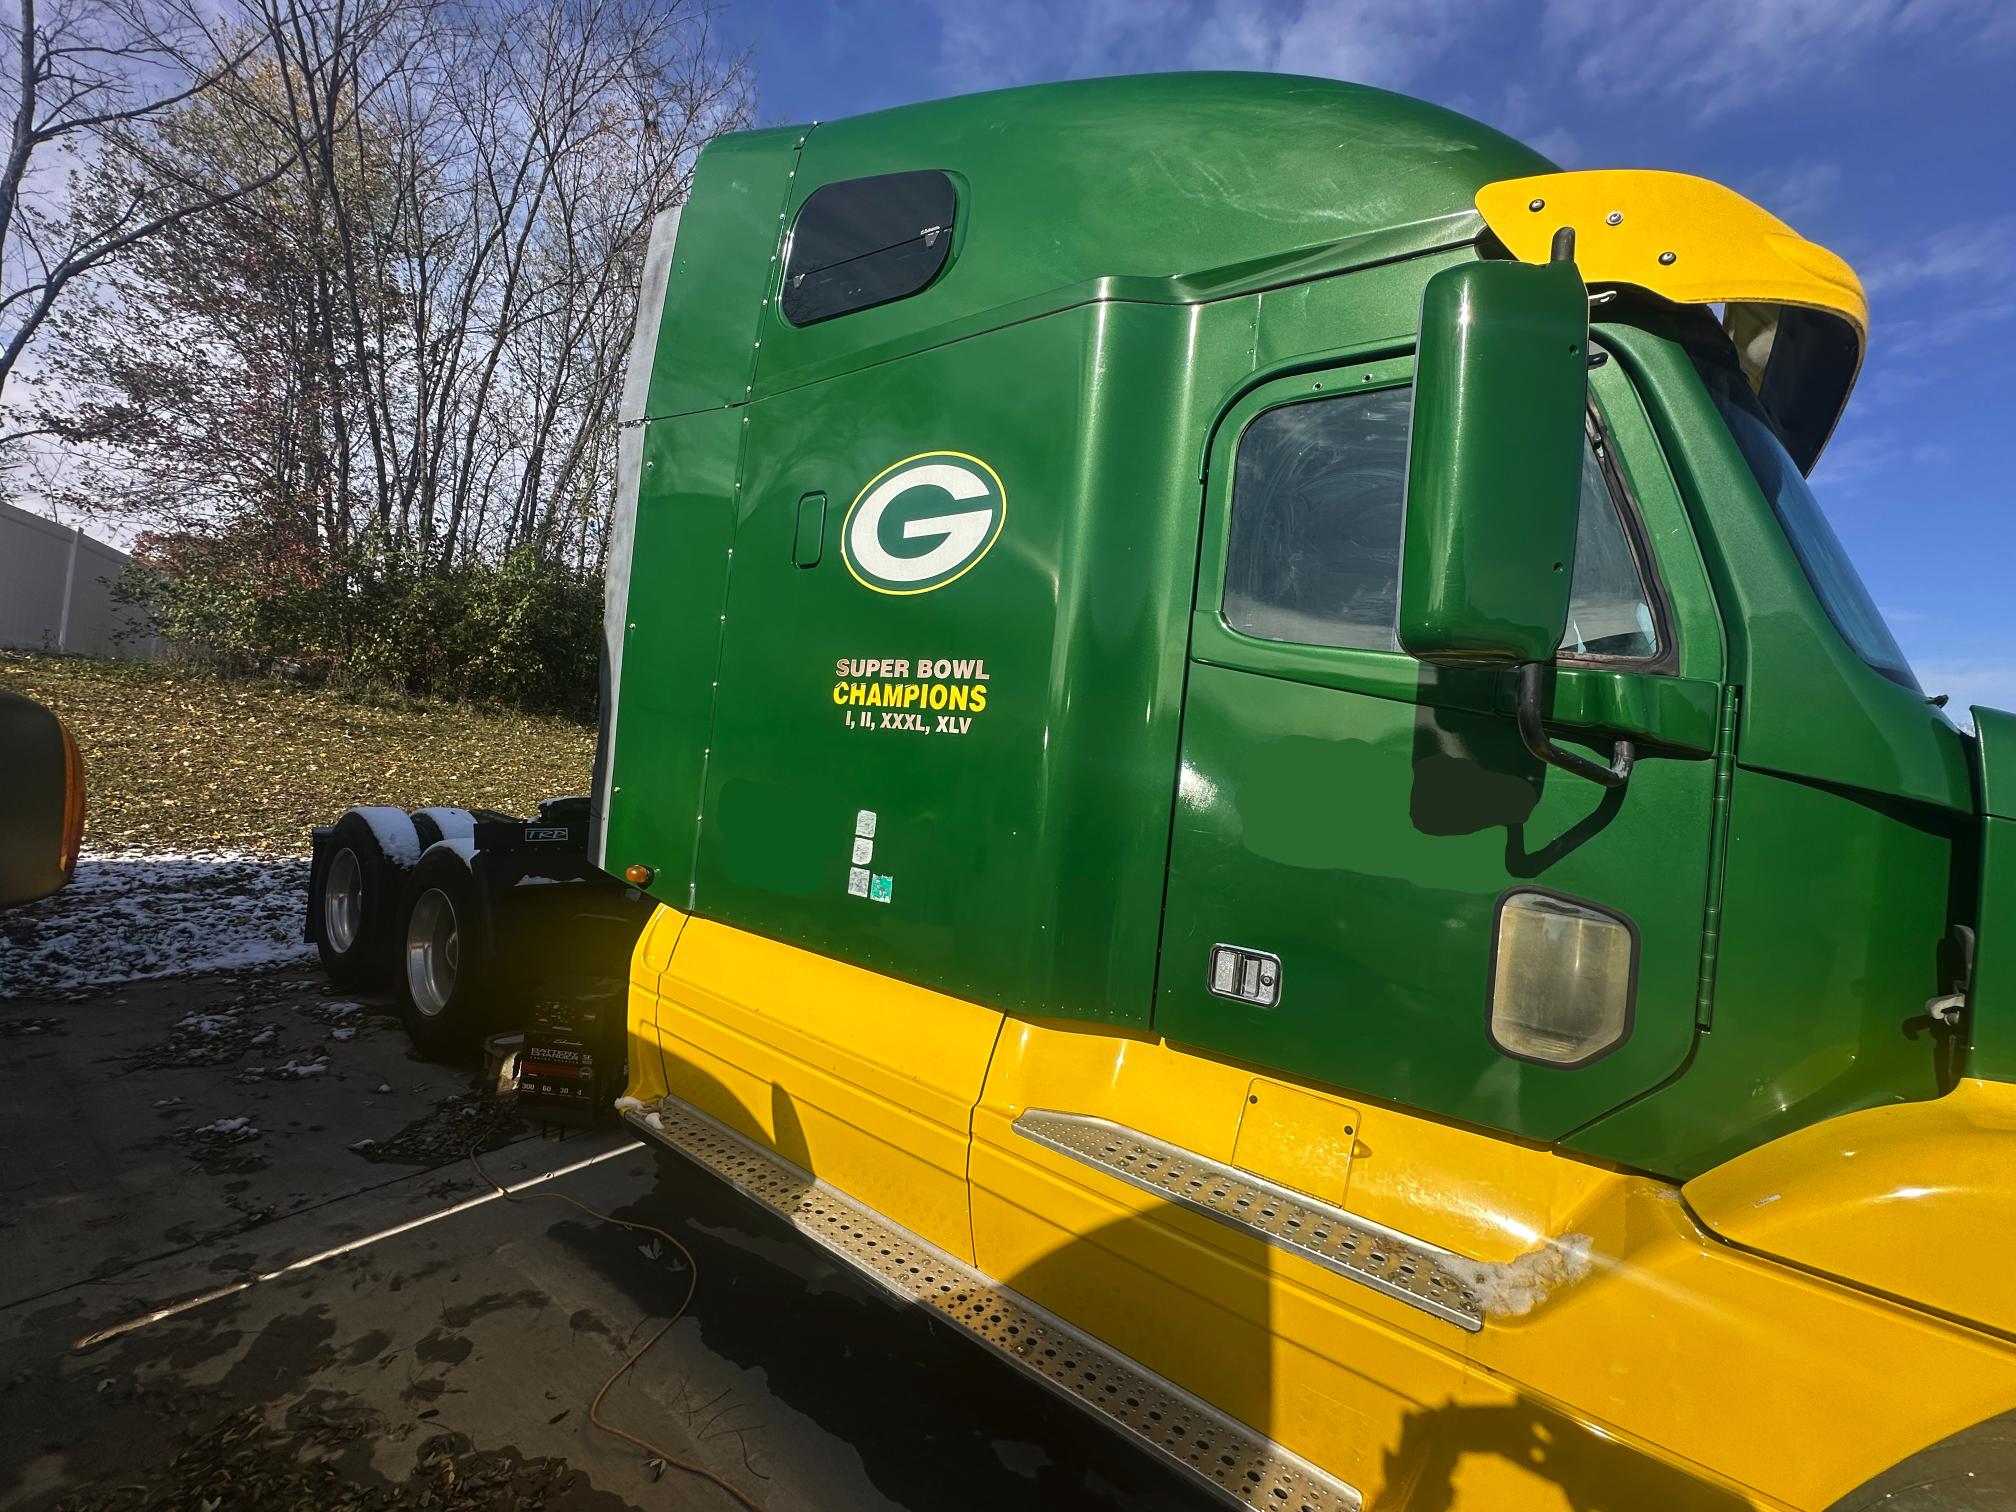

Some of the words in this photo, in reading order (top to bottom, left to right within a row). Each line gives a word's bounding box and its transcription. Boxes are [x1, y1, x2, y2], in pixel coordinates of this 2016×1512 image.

[851, 464, 993, 582] G
[835, 658, 910, 678] SUPER
[917, 659, 990, 680] BOWL
[833, 681, 987, 712] CHAMPIONS
[845, 710, 855, 730] I,
[860, 711, 876, 731] II,
[880, 712, 931, 735] XXXL,
[935, 715, 973, 734] XLV
[527, 830, 567, 839] TRP
